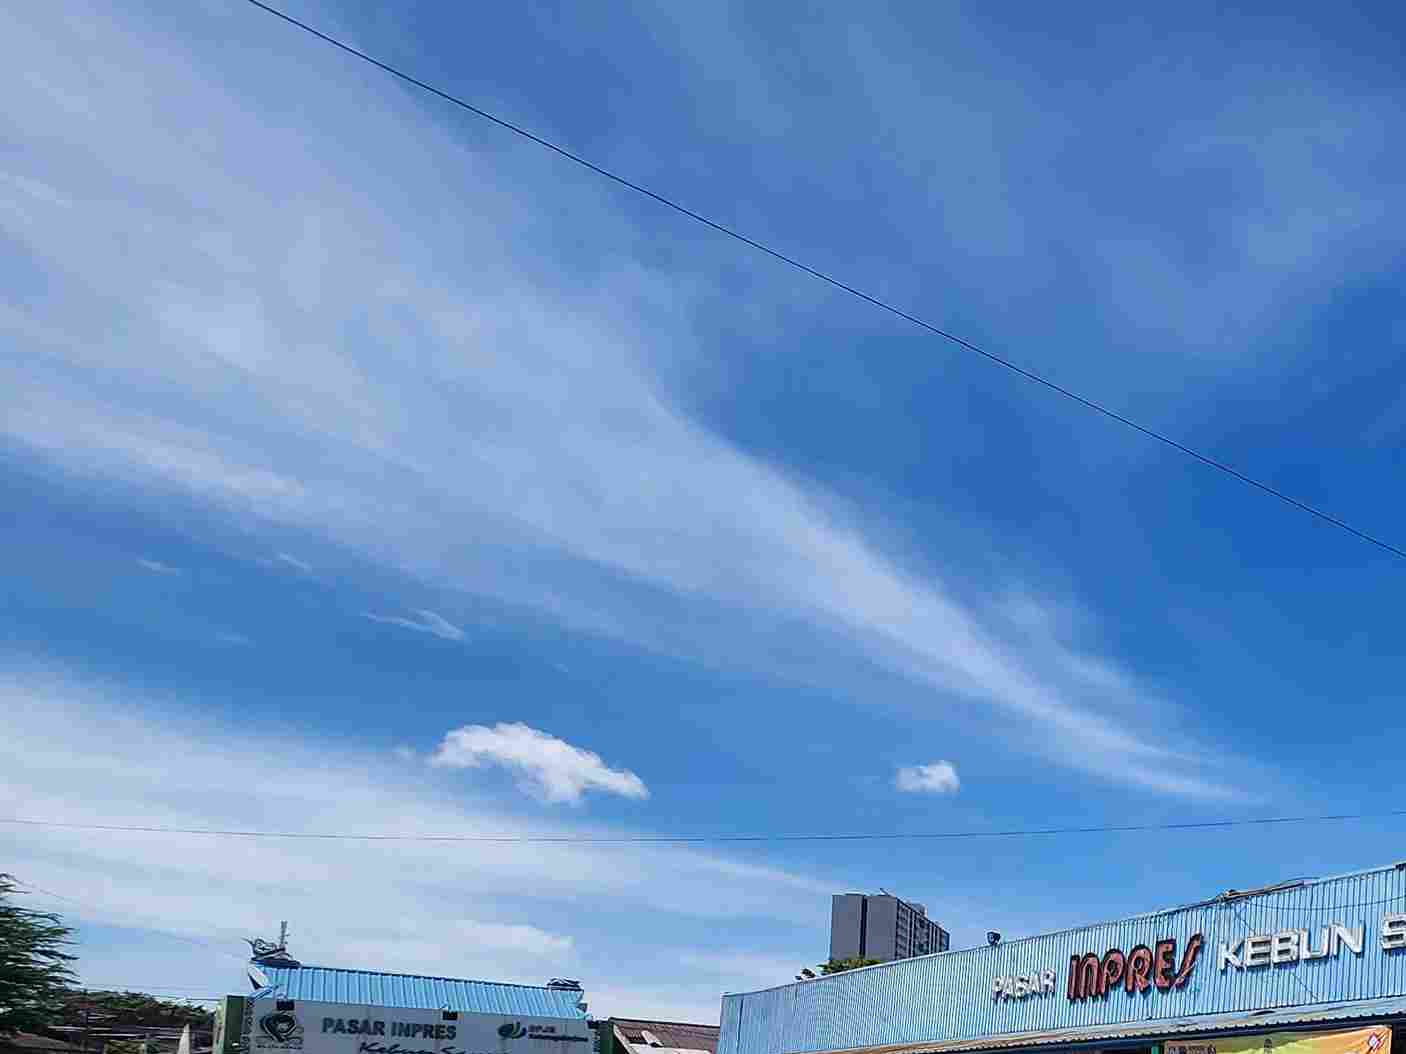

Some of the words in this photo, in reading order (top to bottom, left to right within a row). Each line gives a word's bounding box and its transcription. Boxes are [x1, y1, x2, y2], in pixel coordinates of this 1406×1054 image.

[991, 968, 1056, 1002] PASAR
[1066, 933, 1203, 1003] INPRES
[1217, 919, 1365, 974] KEBUN
[321, 1017, 385, 1037] PASAR
[391, 1022, 456, 1040] INPRES
